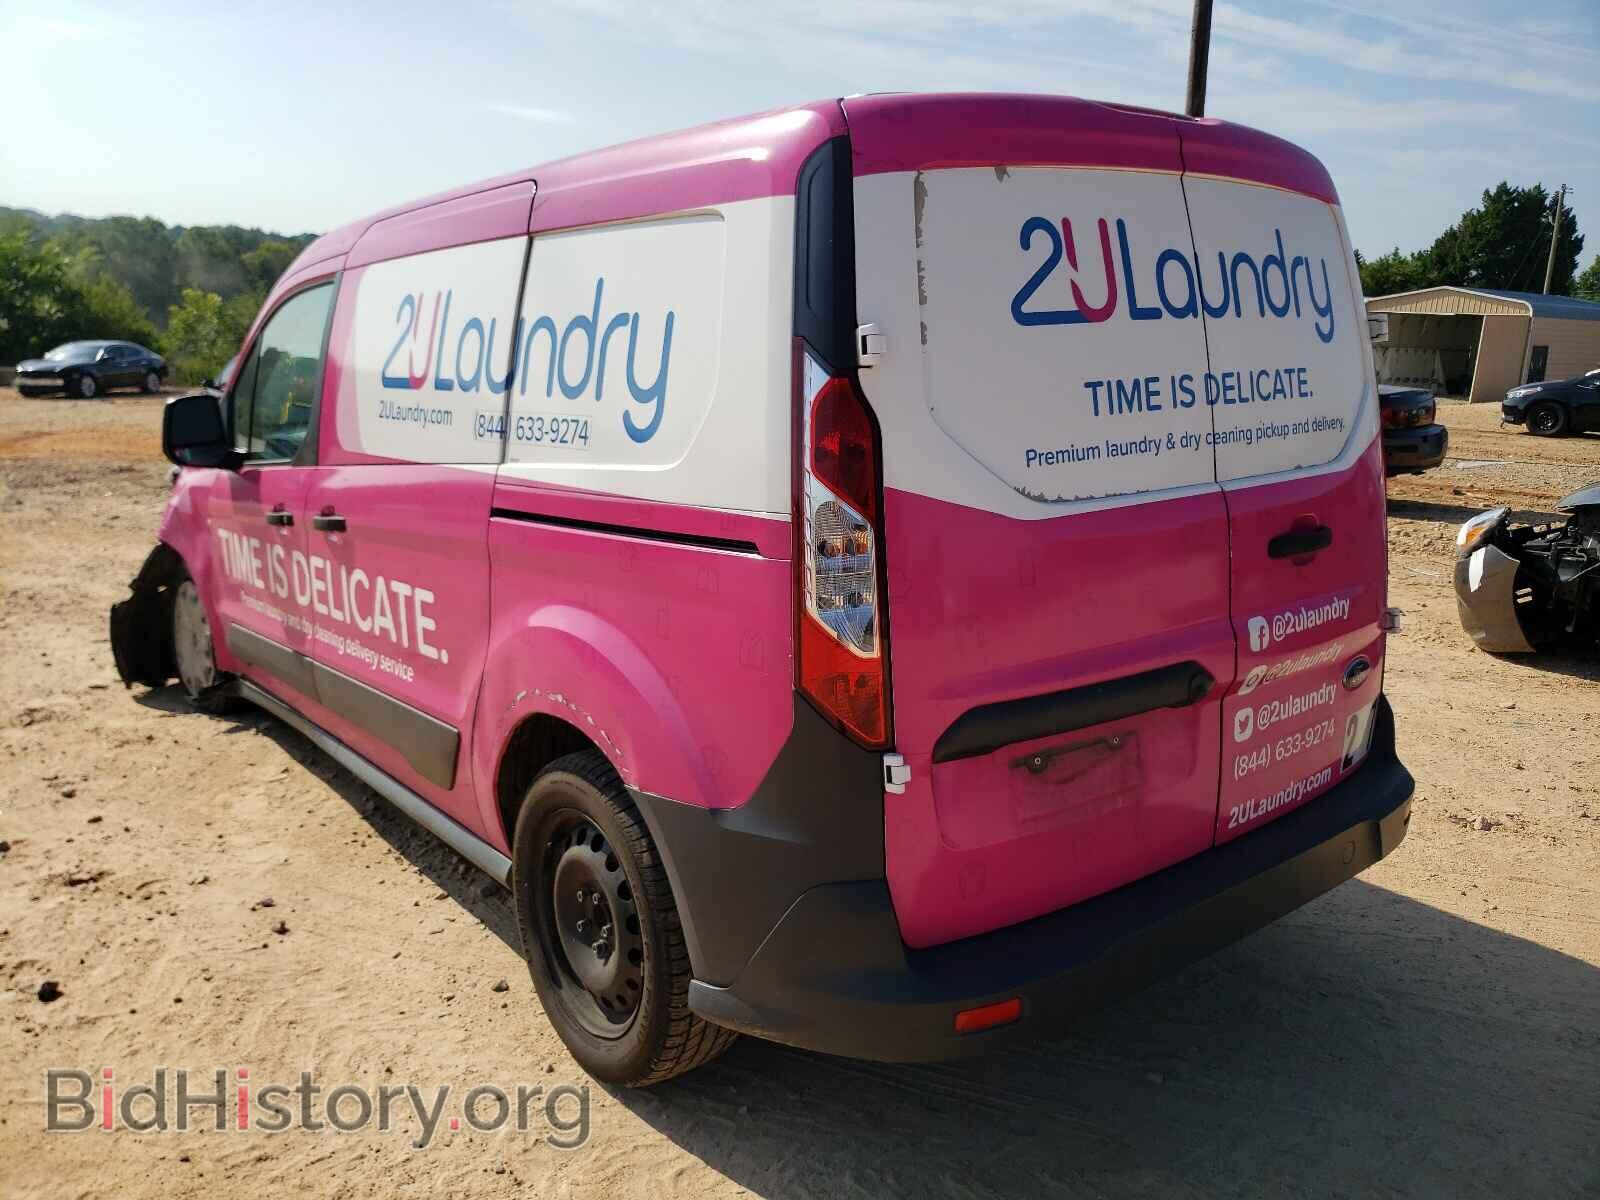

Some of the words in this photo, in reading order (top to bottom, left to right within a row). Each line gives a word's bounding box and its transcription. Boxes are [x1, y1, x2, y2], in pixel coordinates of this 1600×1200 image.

[1010, 216, 1336, 343] 2ULaundry
[381, 277, 675, 443] 2ULaundry
[379, 400, 453, 428] 2ULaundry.com
[1084, 376, 1162, 416] TIME
[1170, 373, 1196, 409] IS
[1205, 367, 1314, 406] DELICATE.
[516, 416, 590, 446] 633-9274
[1026, 443, 1101, 467] Premium
[1106, 433, 1162, 458] laundry
[1166, 432, 1177, 450] &
[1180, 430, 1201, 451] dry
[1205, 425, 1252, 446] ceaning
[1256, 420, 1290, 443] pickup
[1292, 417, 1310, 435] and
[1311, 415, 1346, 433] delivery.
[217, 527, 265, 589] TIME
[266, 543, 289, 599] IS
[292, 550, 449, 664] DELICATE.
[1272, 596, 1350, 642] @2ulaundry
[345, 635, 379, 670] delivery
[379, 652, 415, 682] service
[1257, 683, 1337, 730] @2ulaundry
[1234, 743, 1271, 780] (844)
[1275, 718, 1336, 761] 633-9274
[1228, 766, 1332, 829] 2ULaundry.com
